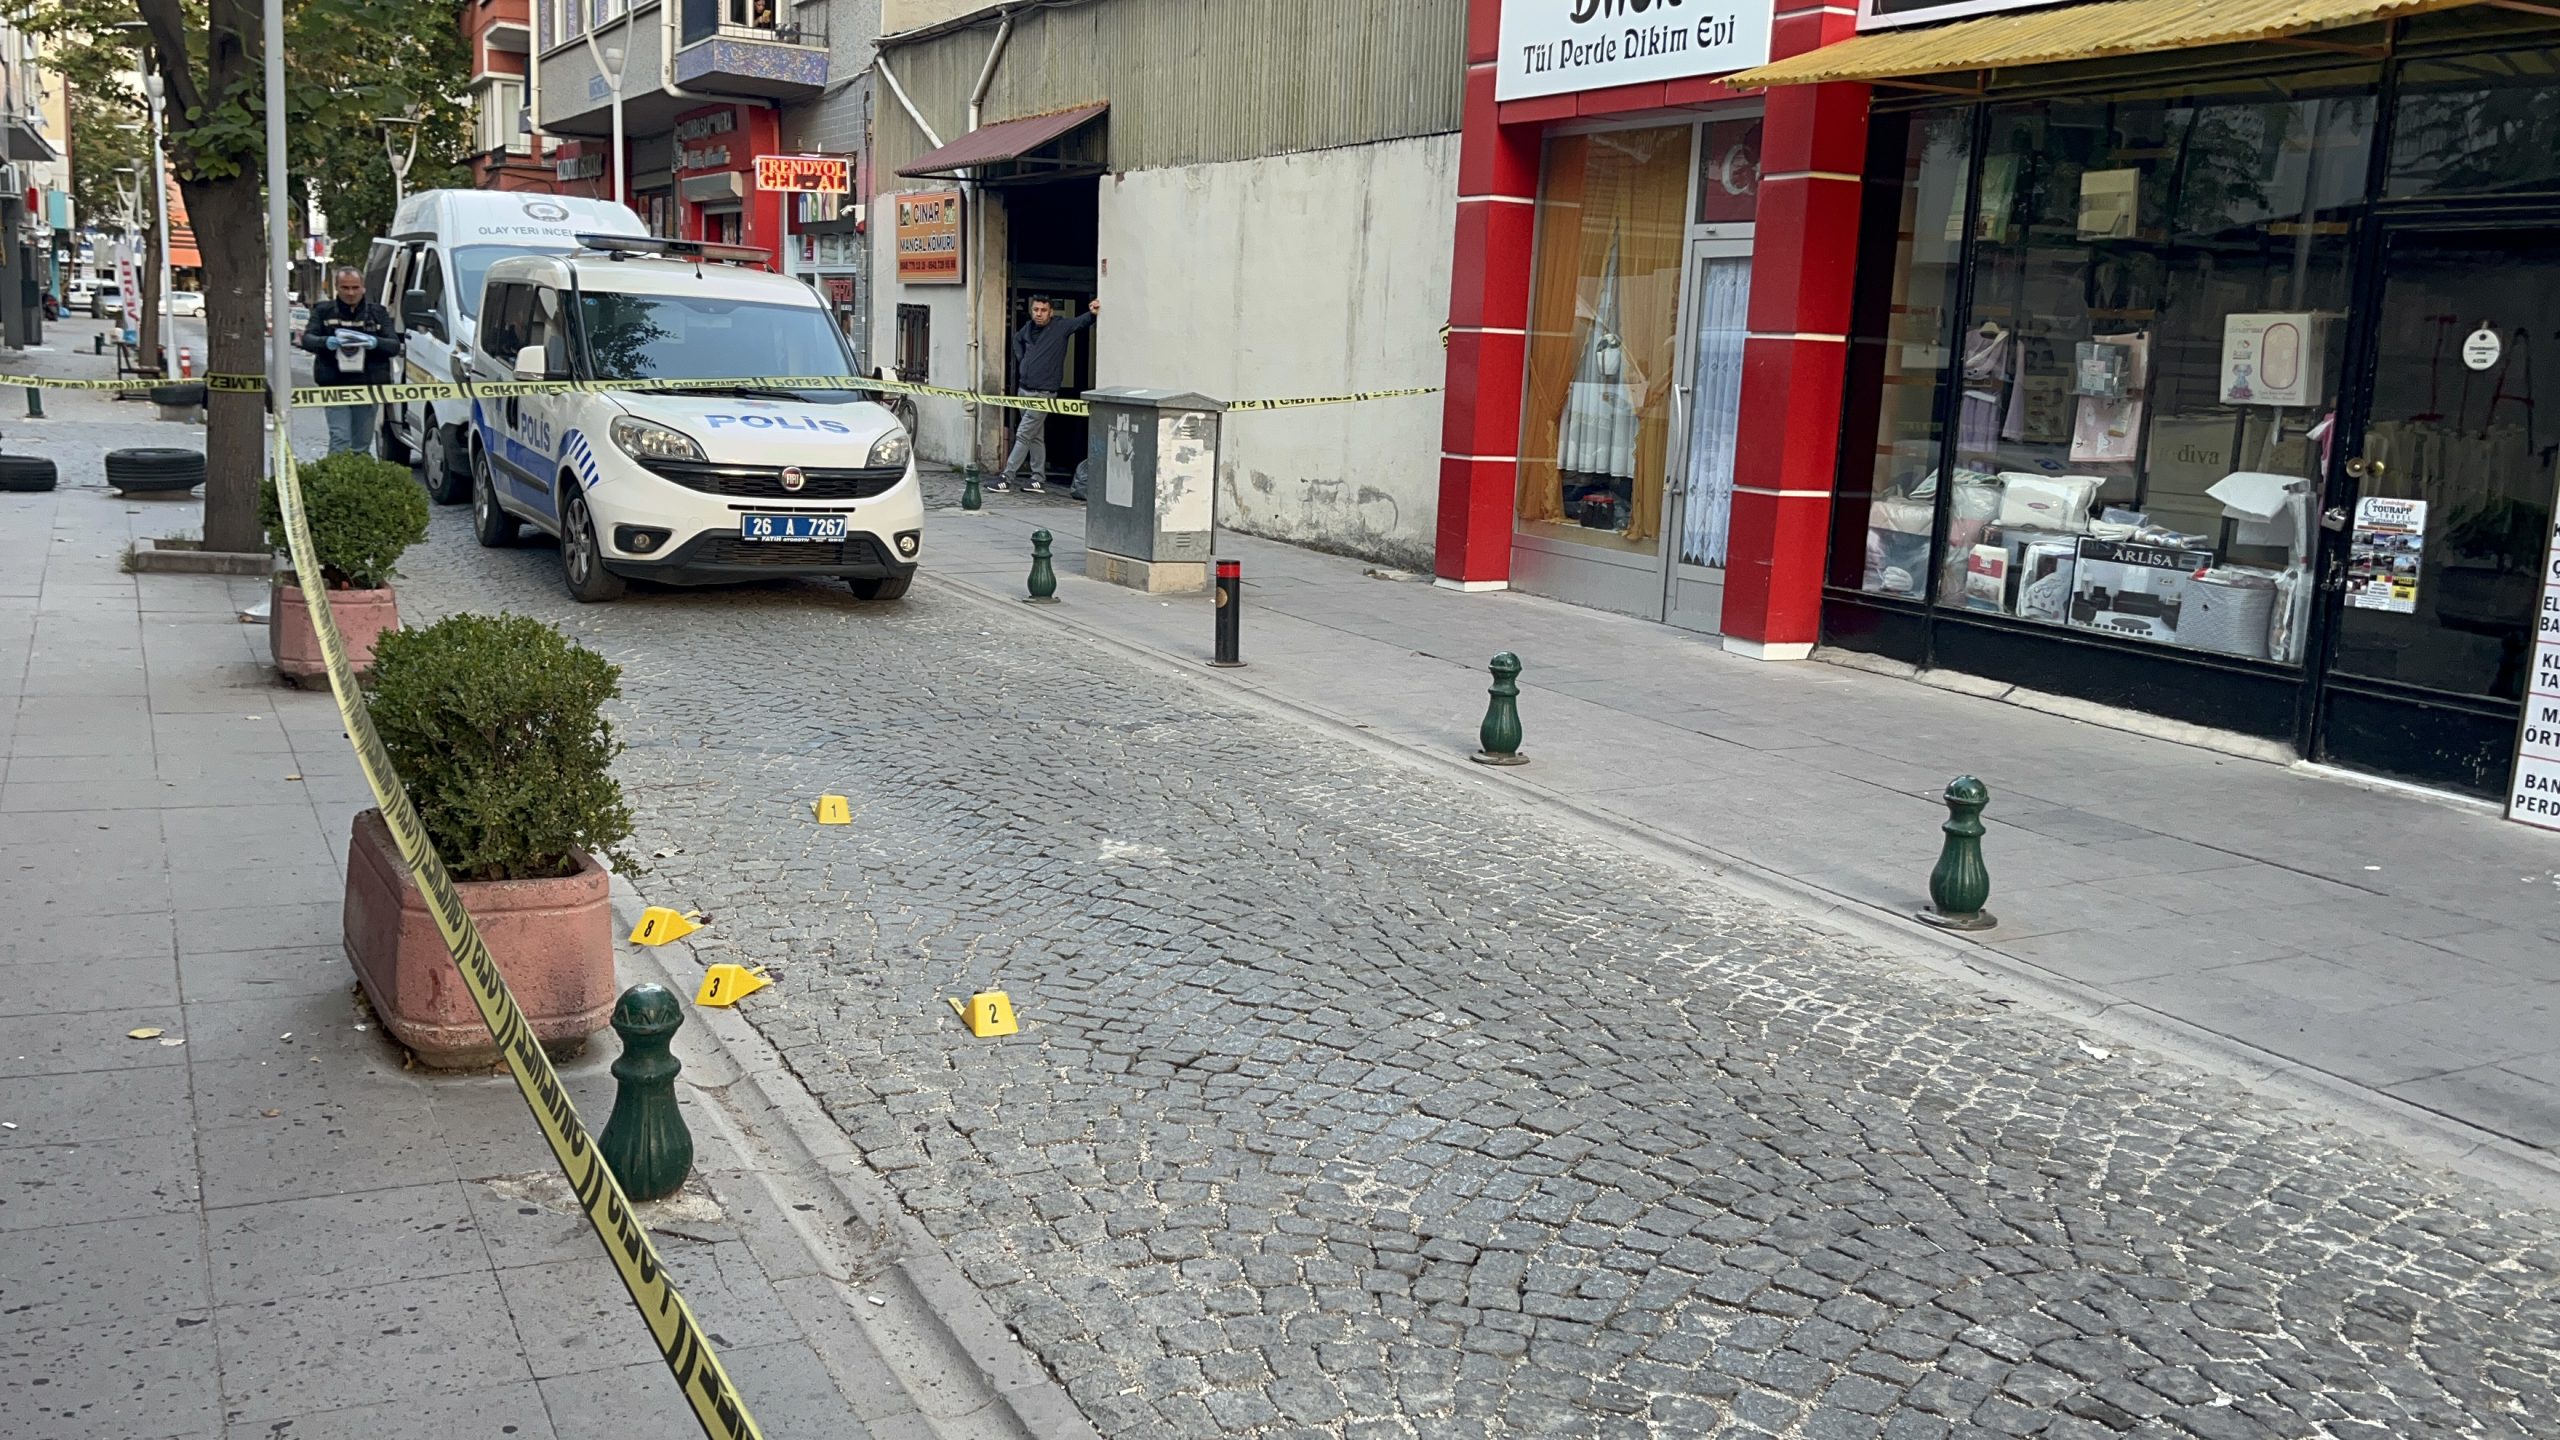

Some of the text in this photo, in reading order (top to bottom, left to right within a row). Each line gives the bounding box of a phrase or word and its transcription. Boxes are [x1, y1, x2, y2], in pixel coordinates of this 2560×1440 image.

[1523, 14, 1736, 74] Tül Perde Dikim Evi
[759, 158, 847, 177] TRENDYOL
[759, 173, 801, 190] GEL
[816, 175, 846, 192] AL
[478, 226, 509, 236] OLAY
[542, 227, 597, 237] İNCELE
[899, 230, 956, 253] MANGAL KÖMÜRÜ
[520, 411, 551, 453] POLİS
[703, 414, 851, 435] POLİS
[786, 472, 800, 485] FIAT
[752, 517, 845, 537] 26 A 7267
[2111, 548, 2174, 568] ARLİSA
[2541, 706, 2560, 725] M
[830, 802, 838, 819] 1
[642, 919, 655, 938] 8
[708, 976, 721, 998] 3
[988, 1002, 999, 1024] 2
